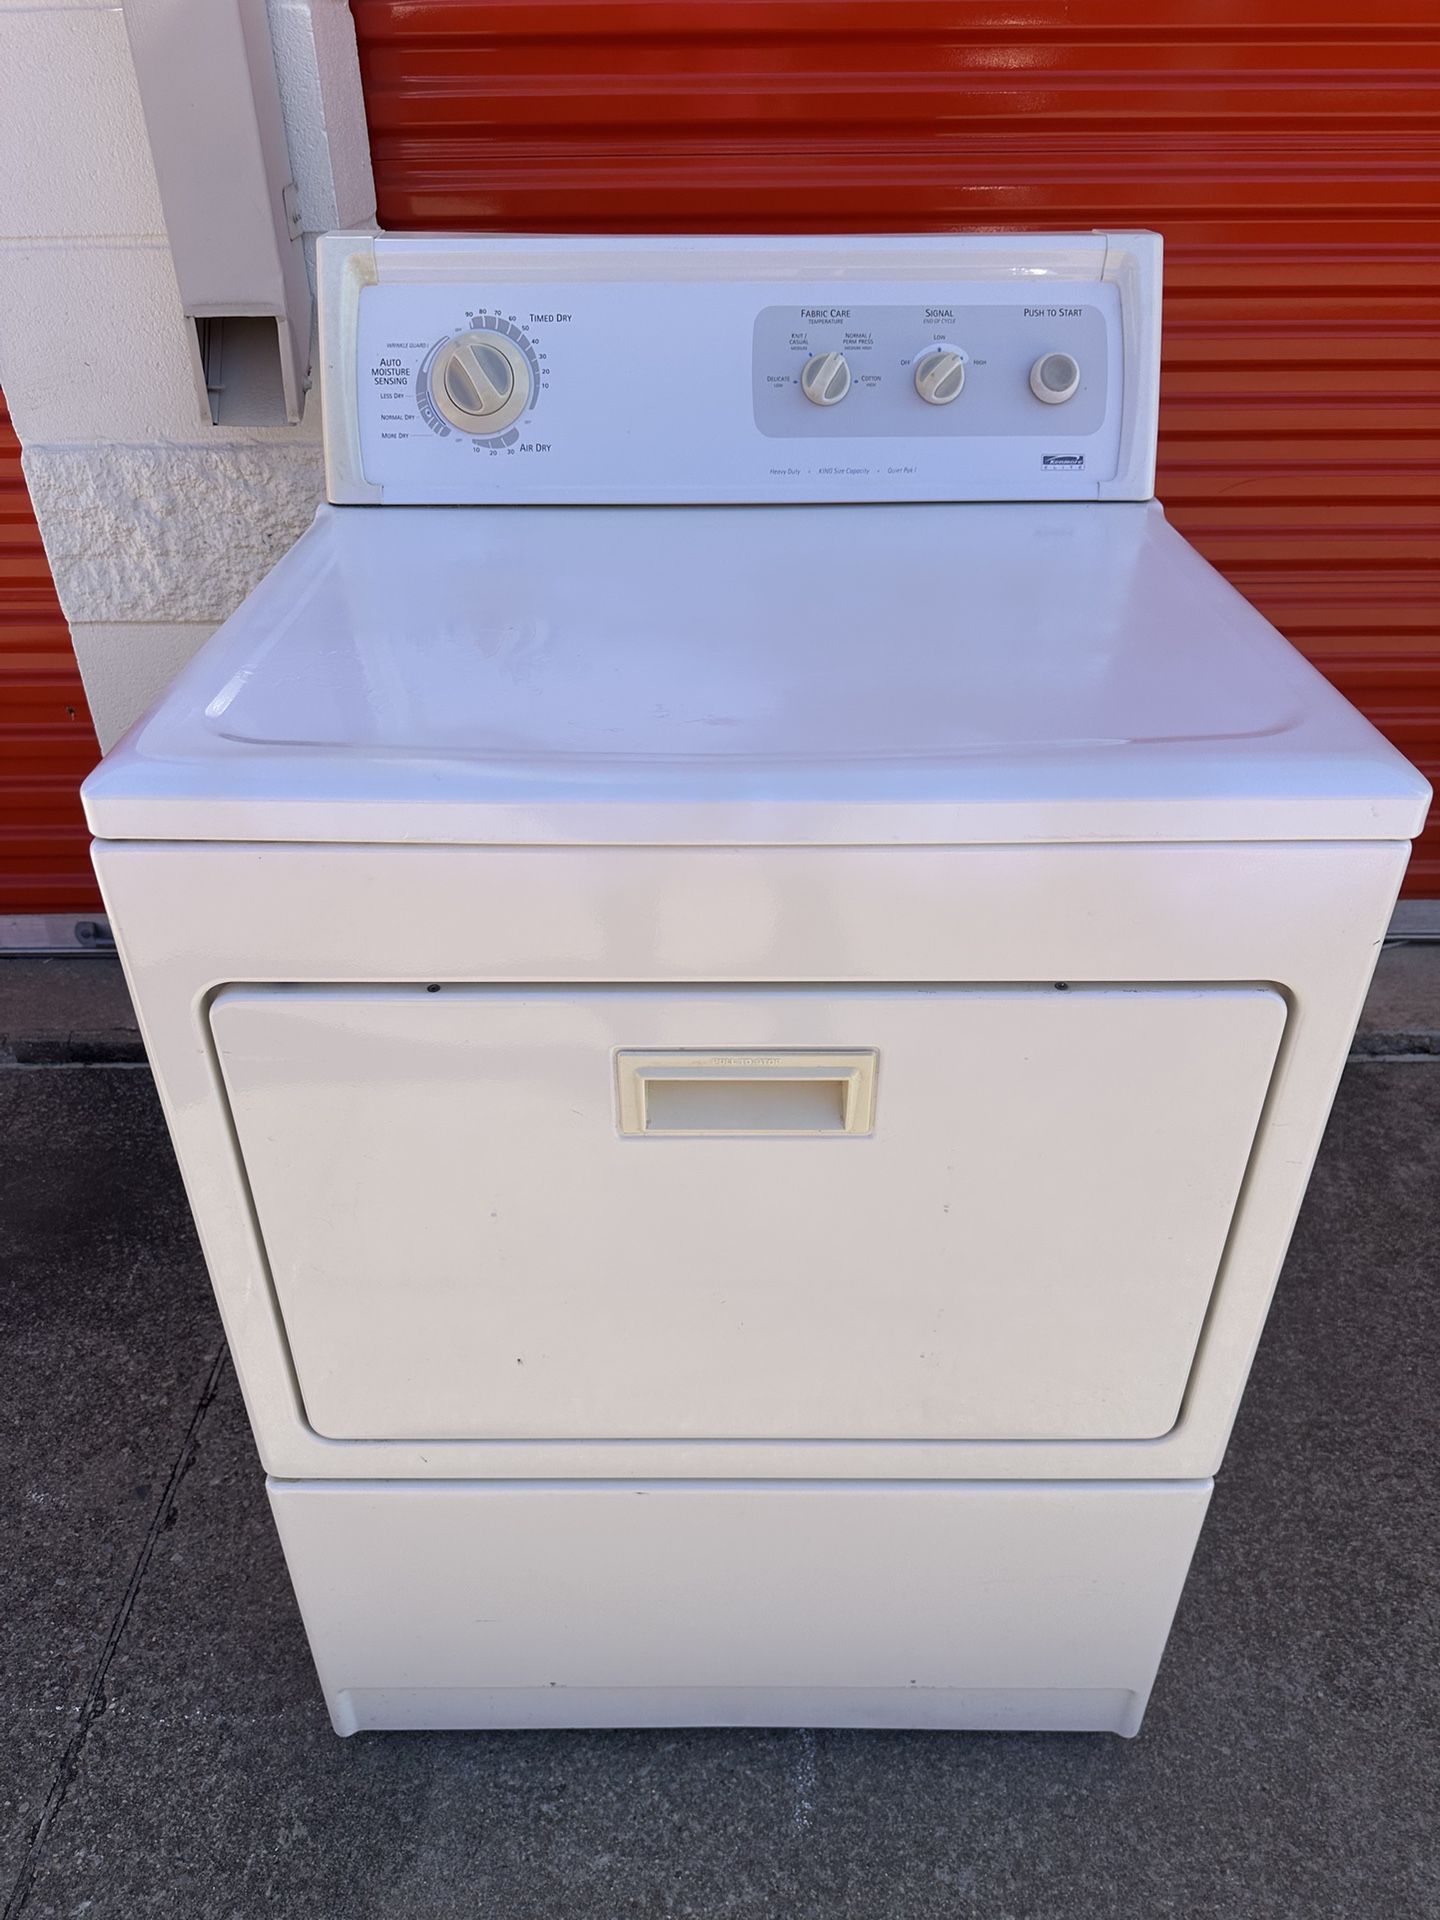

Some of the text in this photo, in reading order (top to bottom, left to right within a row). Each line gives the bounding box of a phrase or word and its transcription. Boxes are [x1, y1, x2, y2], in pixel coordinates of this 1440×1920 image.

[801, 309, 851, 317] FABRIC CARE
[926, 309, 953, 317] SIGNAL
[1024, 309, 1044, 317] PUSH
[1059, 309, 1082, 317] START
[530, 314, 572, 322] TIMED DRY
[380, 358, 401, 367] AUTO
[371, 368, 410, 376] MOISTURE
[520, 444, 551, 452] AIR DRY
